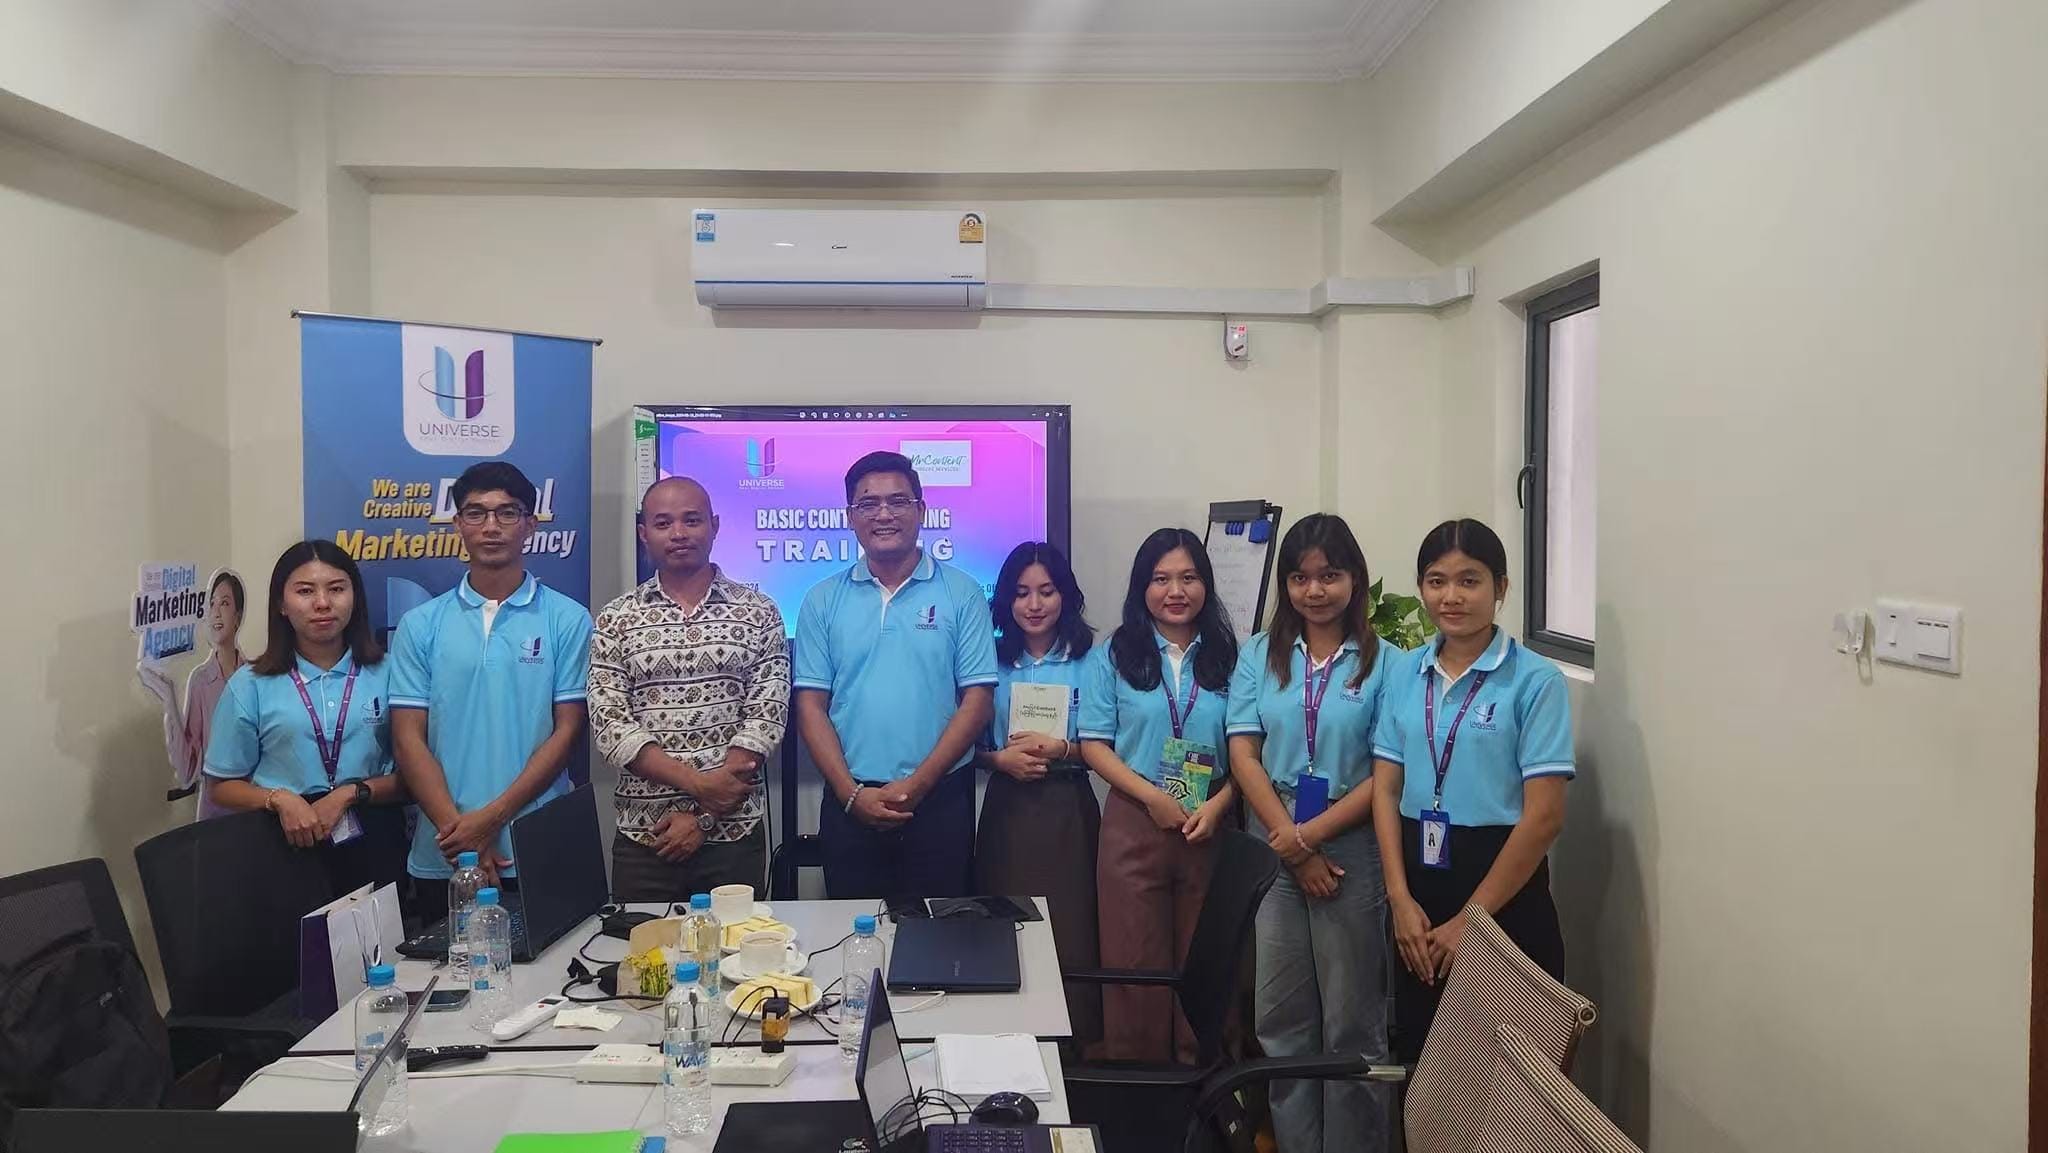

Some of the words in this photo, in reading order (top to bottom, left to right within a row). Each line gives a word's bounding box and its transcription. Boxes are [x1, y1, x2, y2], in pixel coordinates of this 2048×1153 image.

[419, 423, 500, 438] UNIVERSE
[372, 479, 399, 498] We
[404, 481, 431, 497] are
[739, 479, 785, 488] UNIVERSE
[363, 499, 433, 518] Creative
[757, 508, 804, 529] BASIC
[807, 508, 849, 529] CONT
[162, 564, 195, 592] Digital
[136, 587, 206, 627] Marketing
[144, 622, 195, 659] Agency
